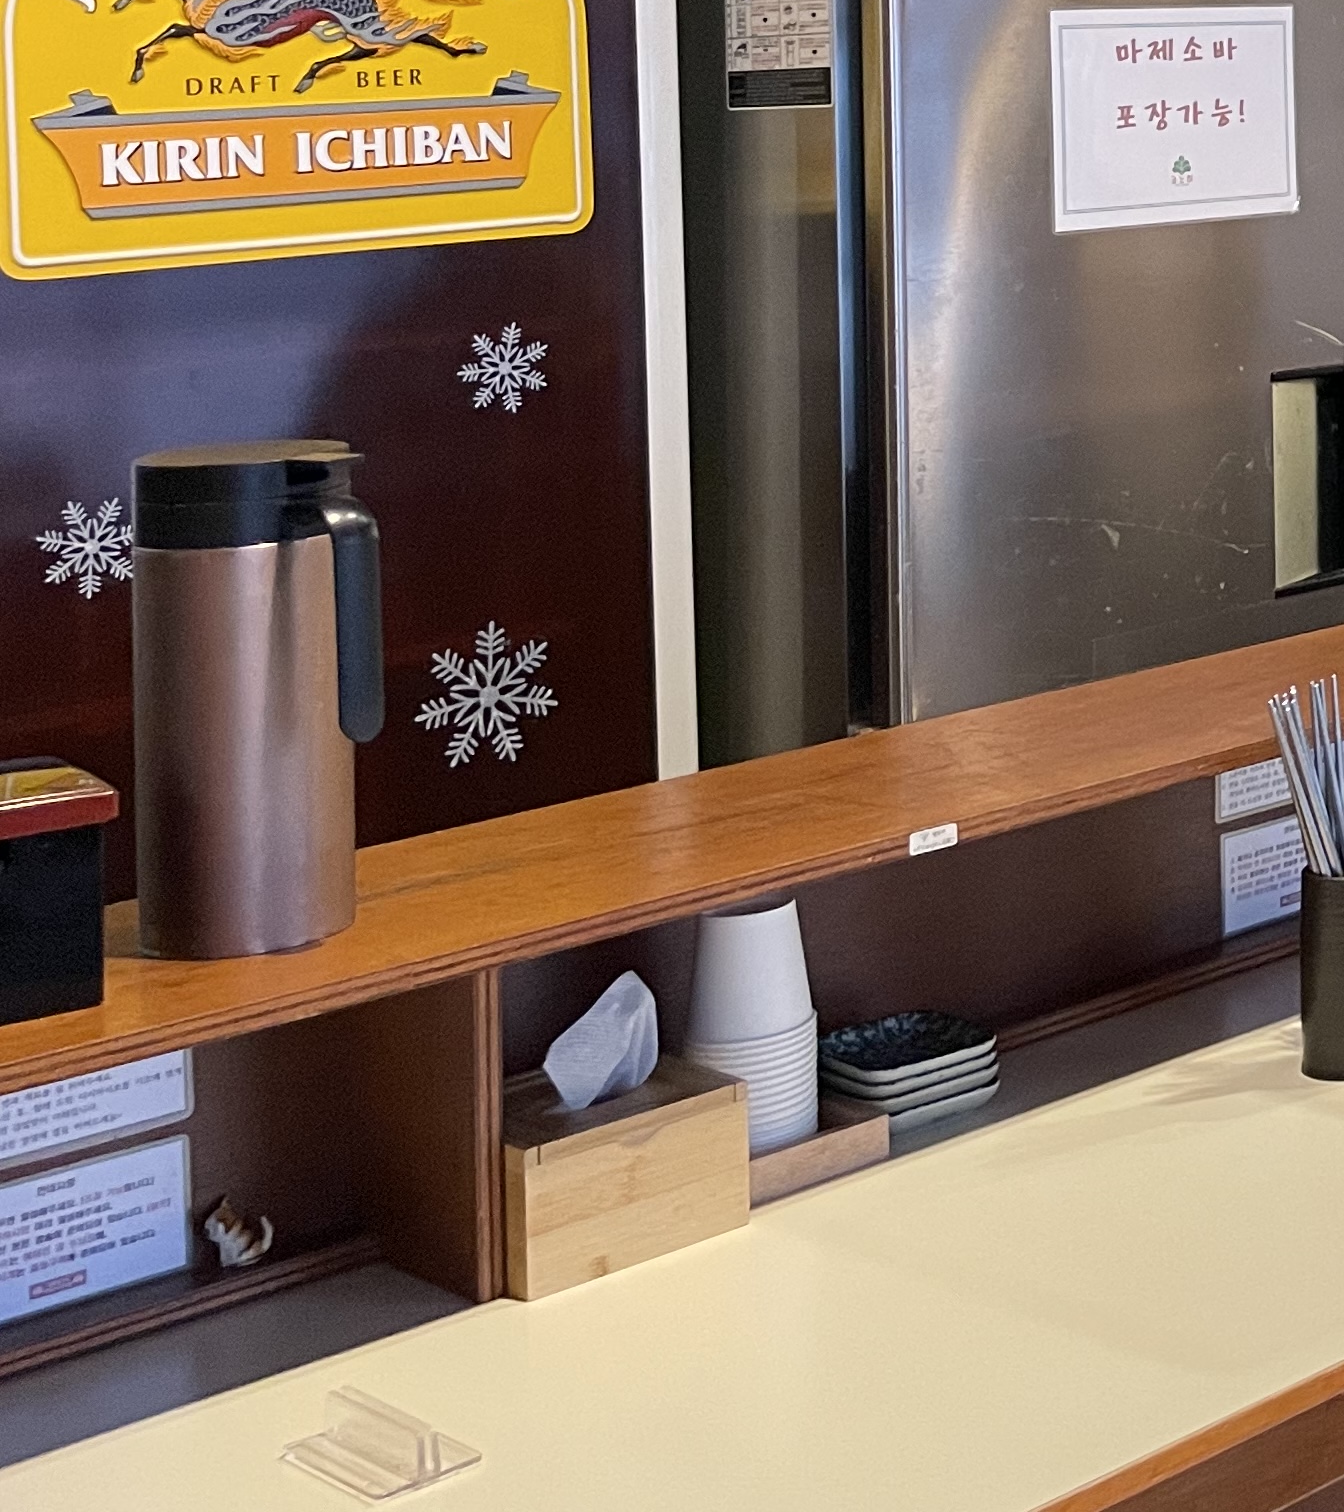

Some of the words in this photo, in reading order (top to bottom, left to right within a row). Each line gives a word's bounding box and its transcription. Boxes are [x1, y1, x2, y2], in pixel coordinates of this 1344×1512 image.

[1115, 36, 1238, 64] 마제소바
[185, 74, 282, 97] DRAFT
[355, 68, 424, 90] BEER
[1115, 97, 1246, 131] 포장가능!
[100, 133, 267, 188] KIRIN
[295, 120, 514, 175] ICHIBAN
